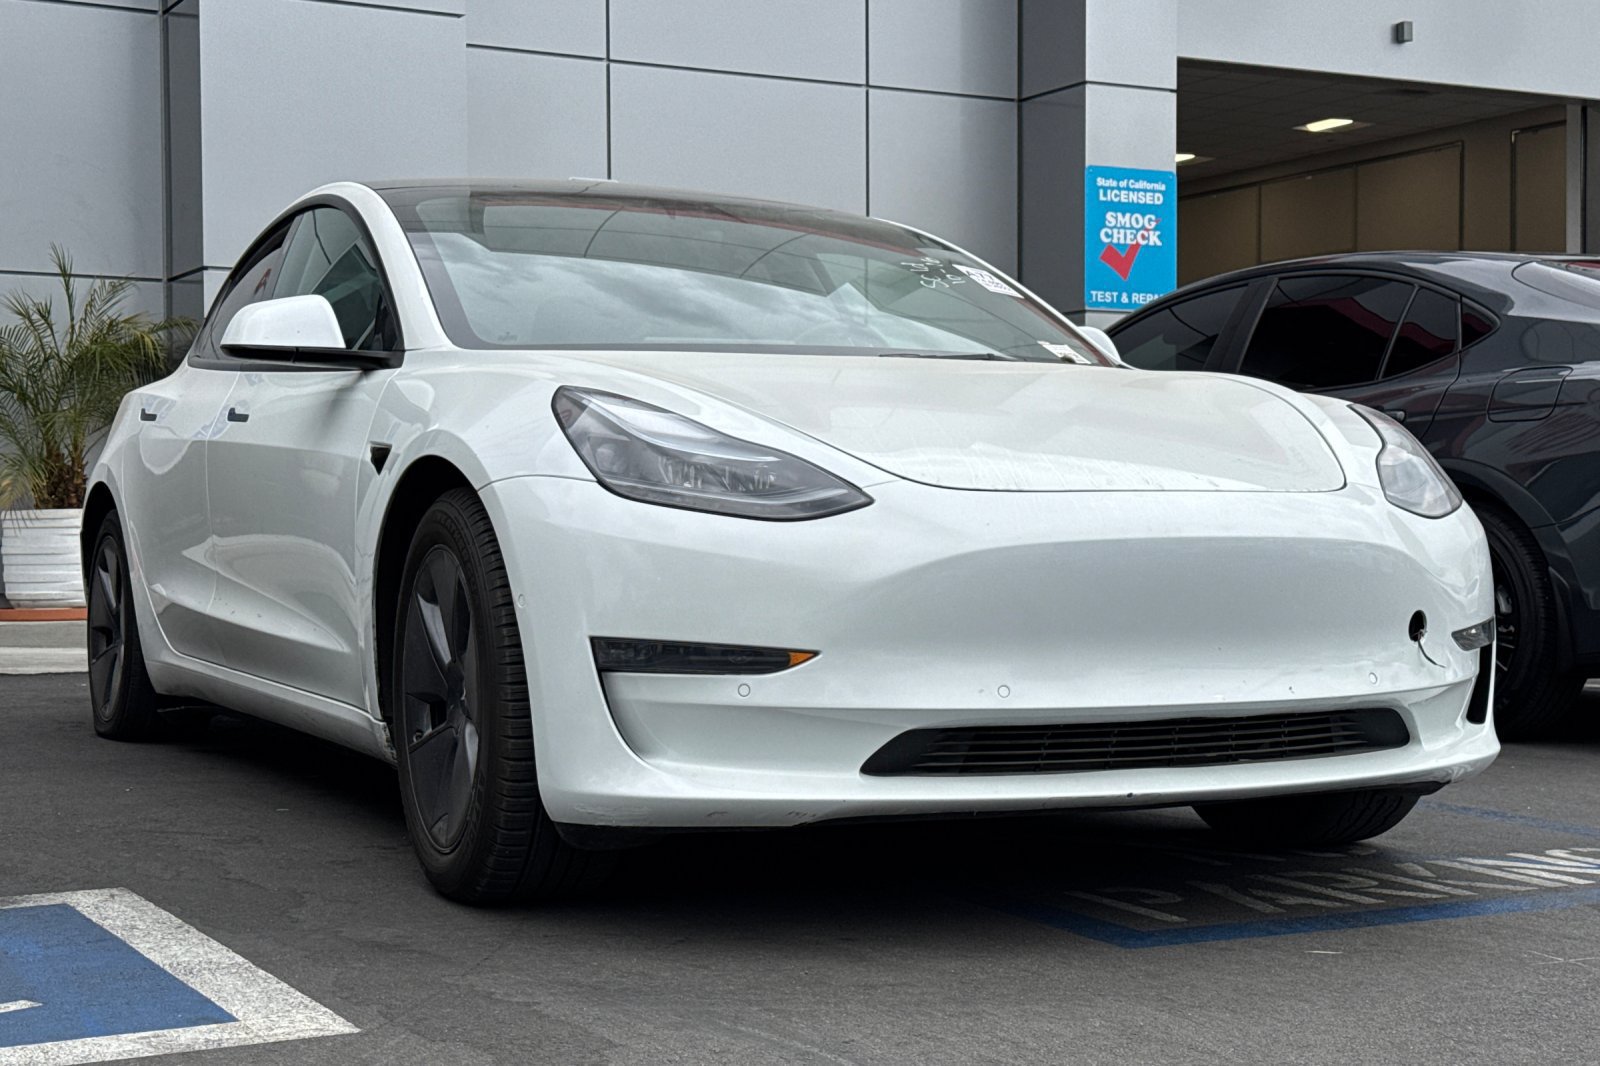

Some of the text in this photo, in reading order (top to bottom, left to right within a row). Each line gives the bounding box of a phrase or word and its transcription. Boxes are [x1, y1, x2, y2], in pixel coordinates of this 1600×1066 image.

[1096, 177, 1166, 191] State of California
[1099, 189, 1163, 204] LICENSED
[1105, 211, 1157, 229] SMOG
[1100, 228, 1163, 246] CHECK
[1090, 290, 1118, 303] TEST
[1121, 292, 1129, 304] &
